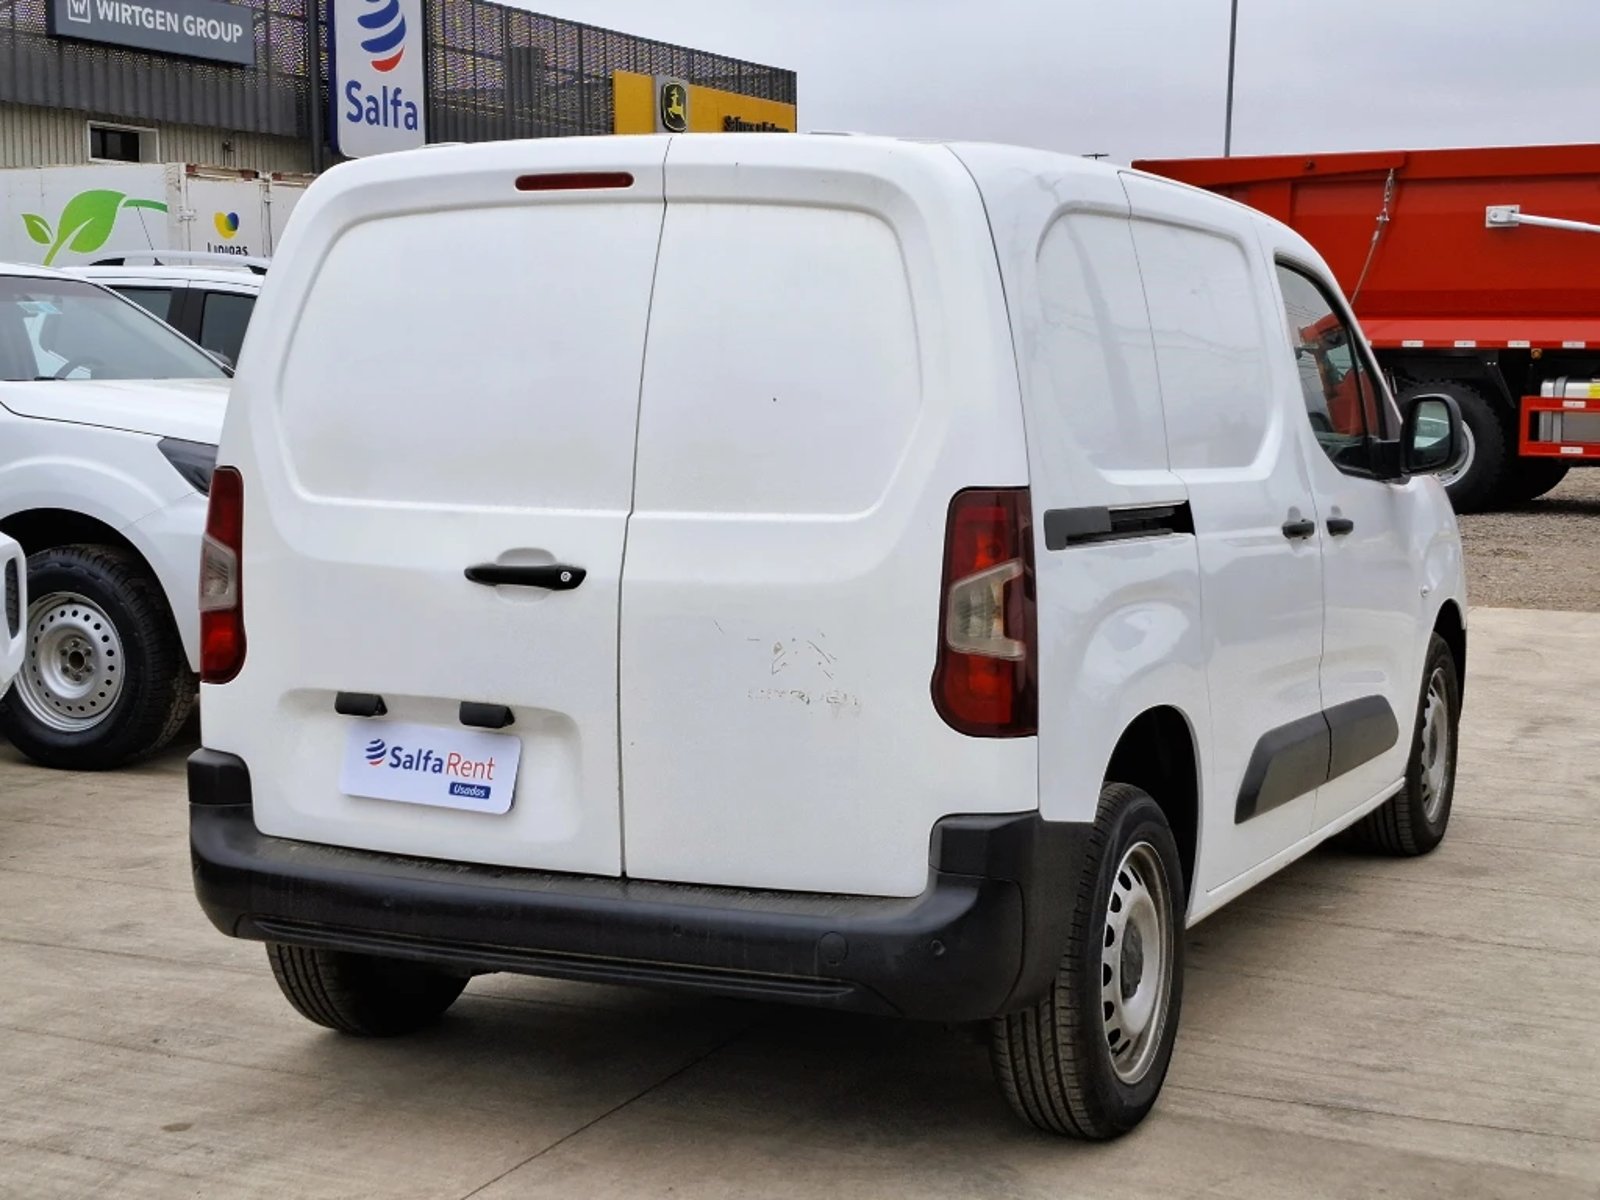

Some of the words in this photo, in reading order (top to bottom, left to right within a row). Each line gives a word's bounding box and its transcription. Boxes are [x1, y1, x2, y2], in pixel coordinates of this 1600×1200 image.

[96, 1, 179, 33] WIRTGEN
[182, 15, 243, 43] GROUP
[345, 79, 418, 131] Salfa
[453, 784, 486, 797] Usados
